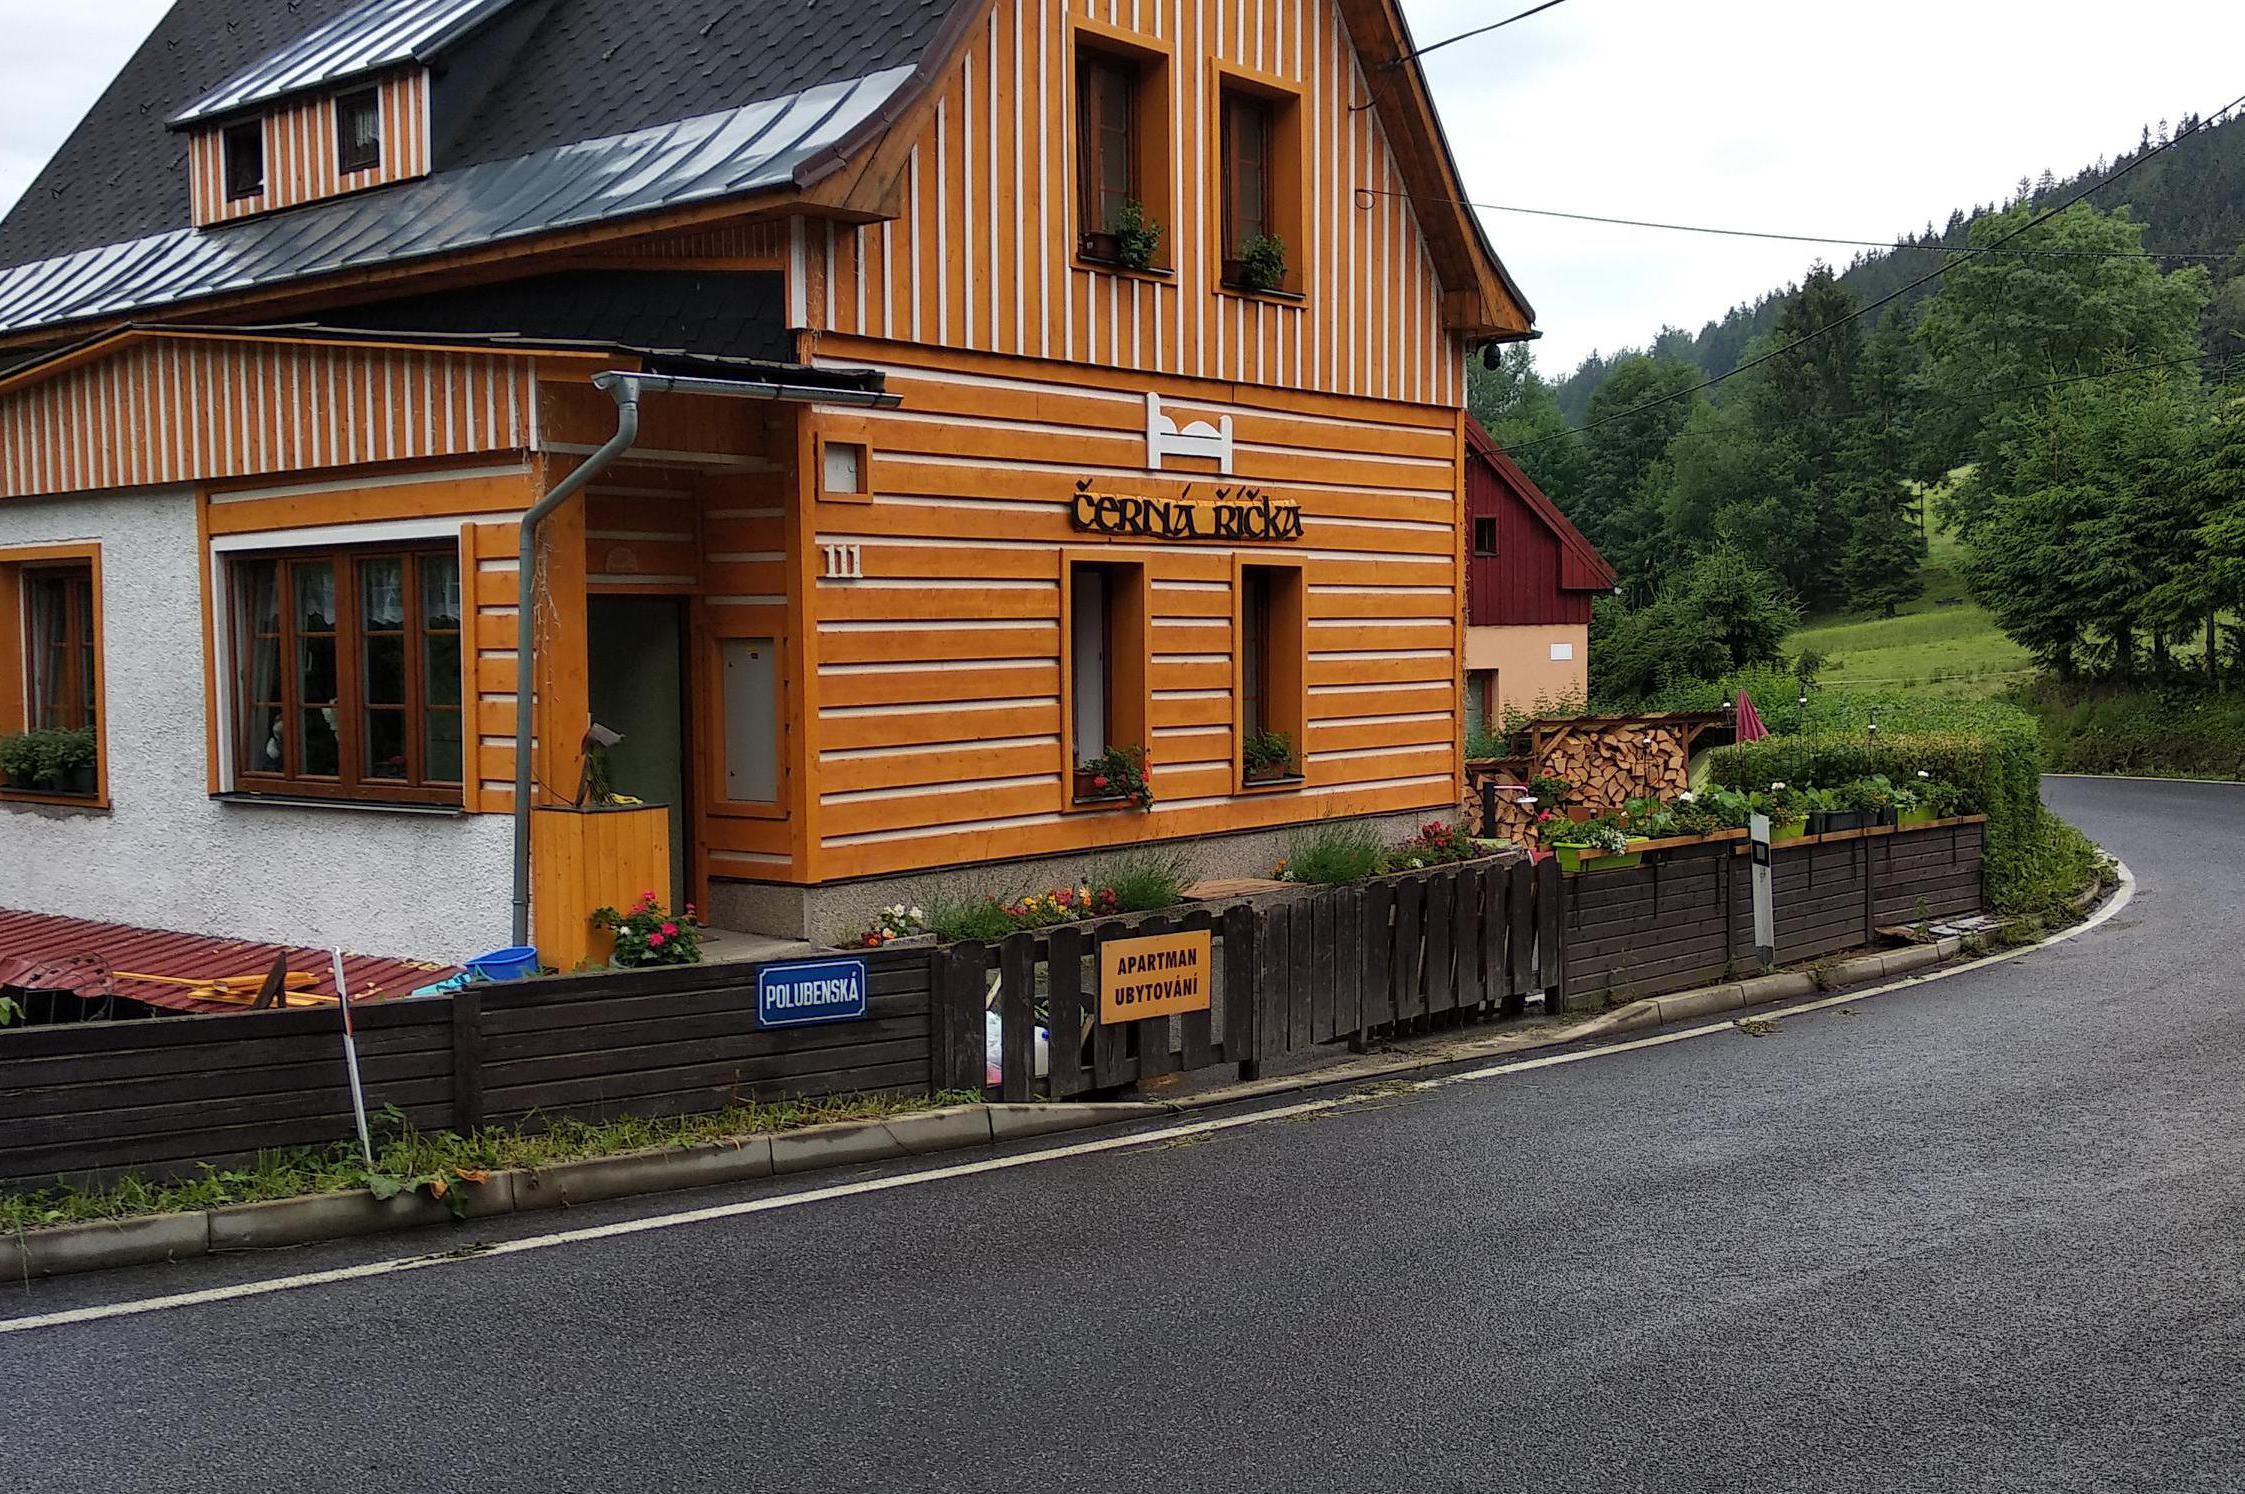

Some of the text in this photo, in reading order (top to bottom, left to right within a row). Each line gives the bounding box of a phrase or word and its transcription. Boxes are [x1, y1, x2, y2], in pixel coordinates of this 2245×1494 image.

[823, 544, 864, 578] 111
[1117, 947, 1197, 975] APARTMAN
[765, 971, 859, 1010] POLUBENSKÁ
[1115, 972, 1198, 1006] UBYTOVÁNÍ
